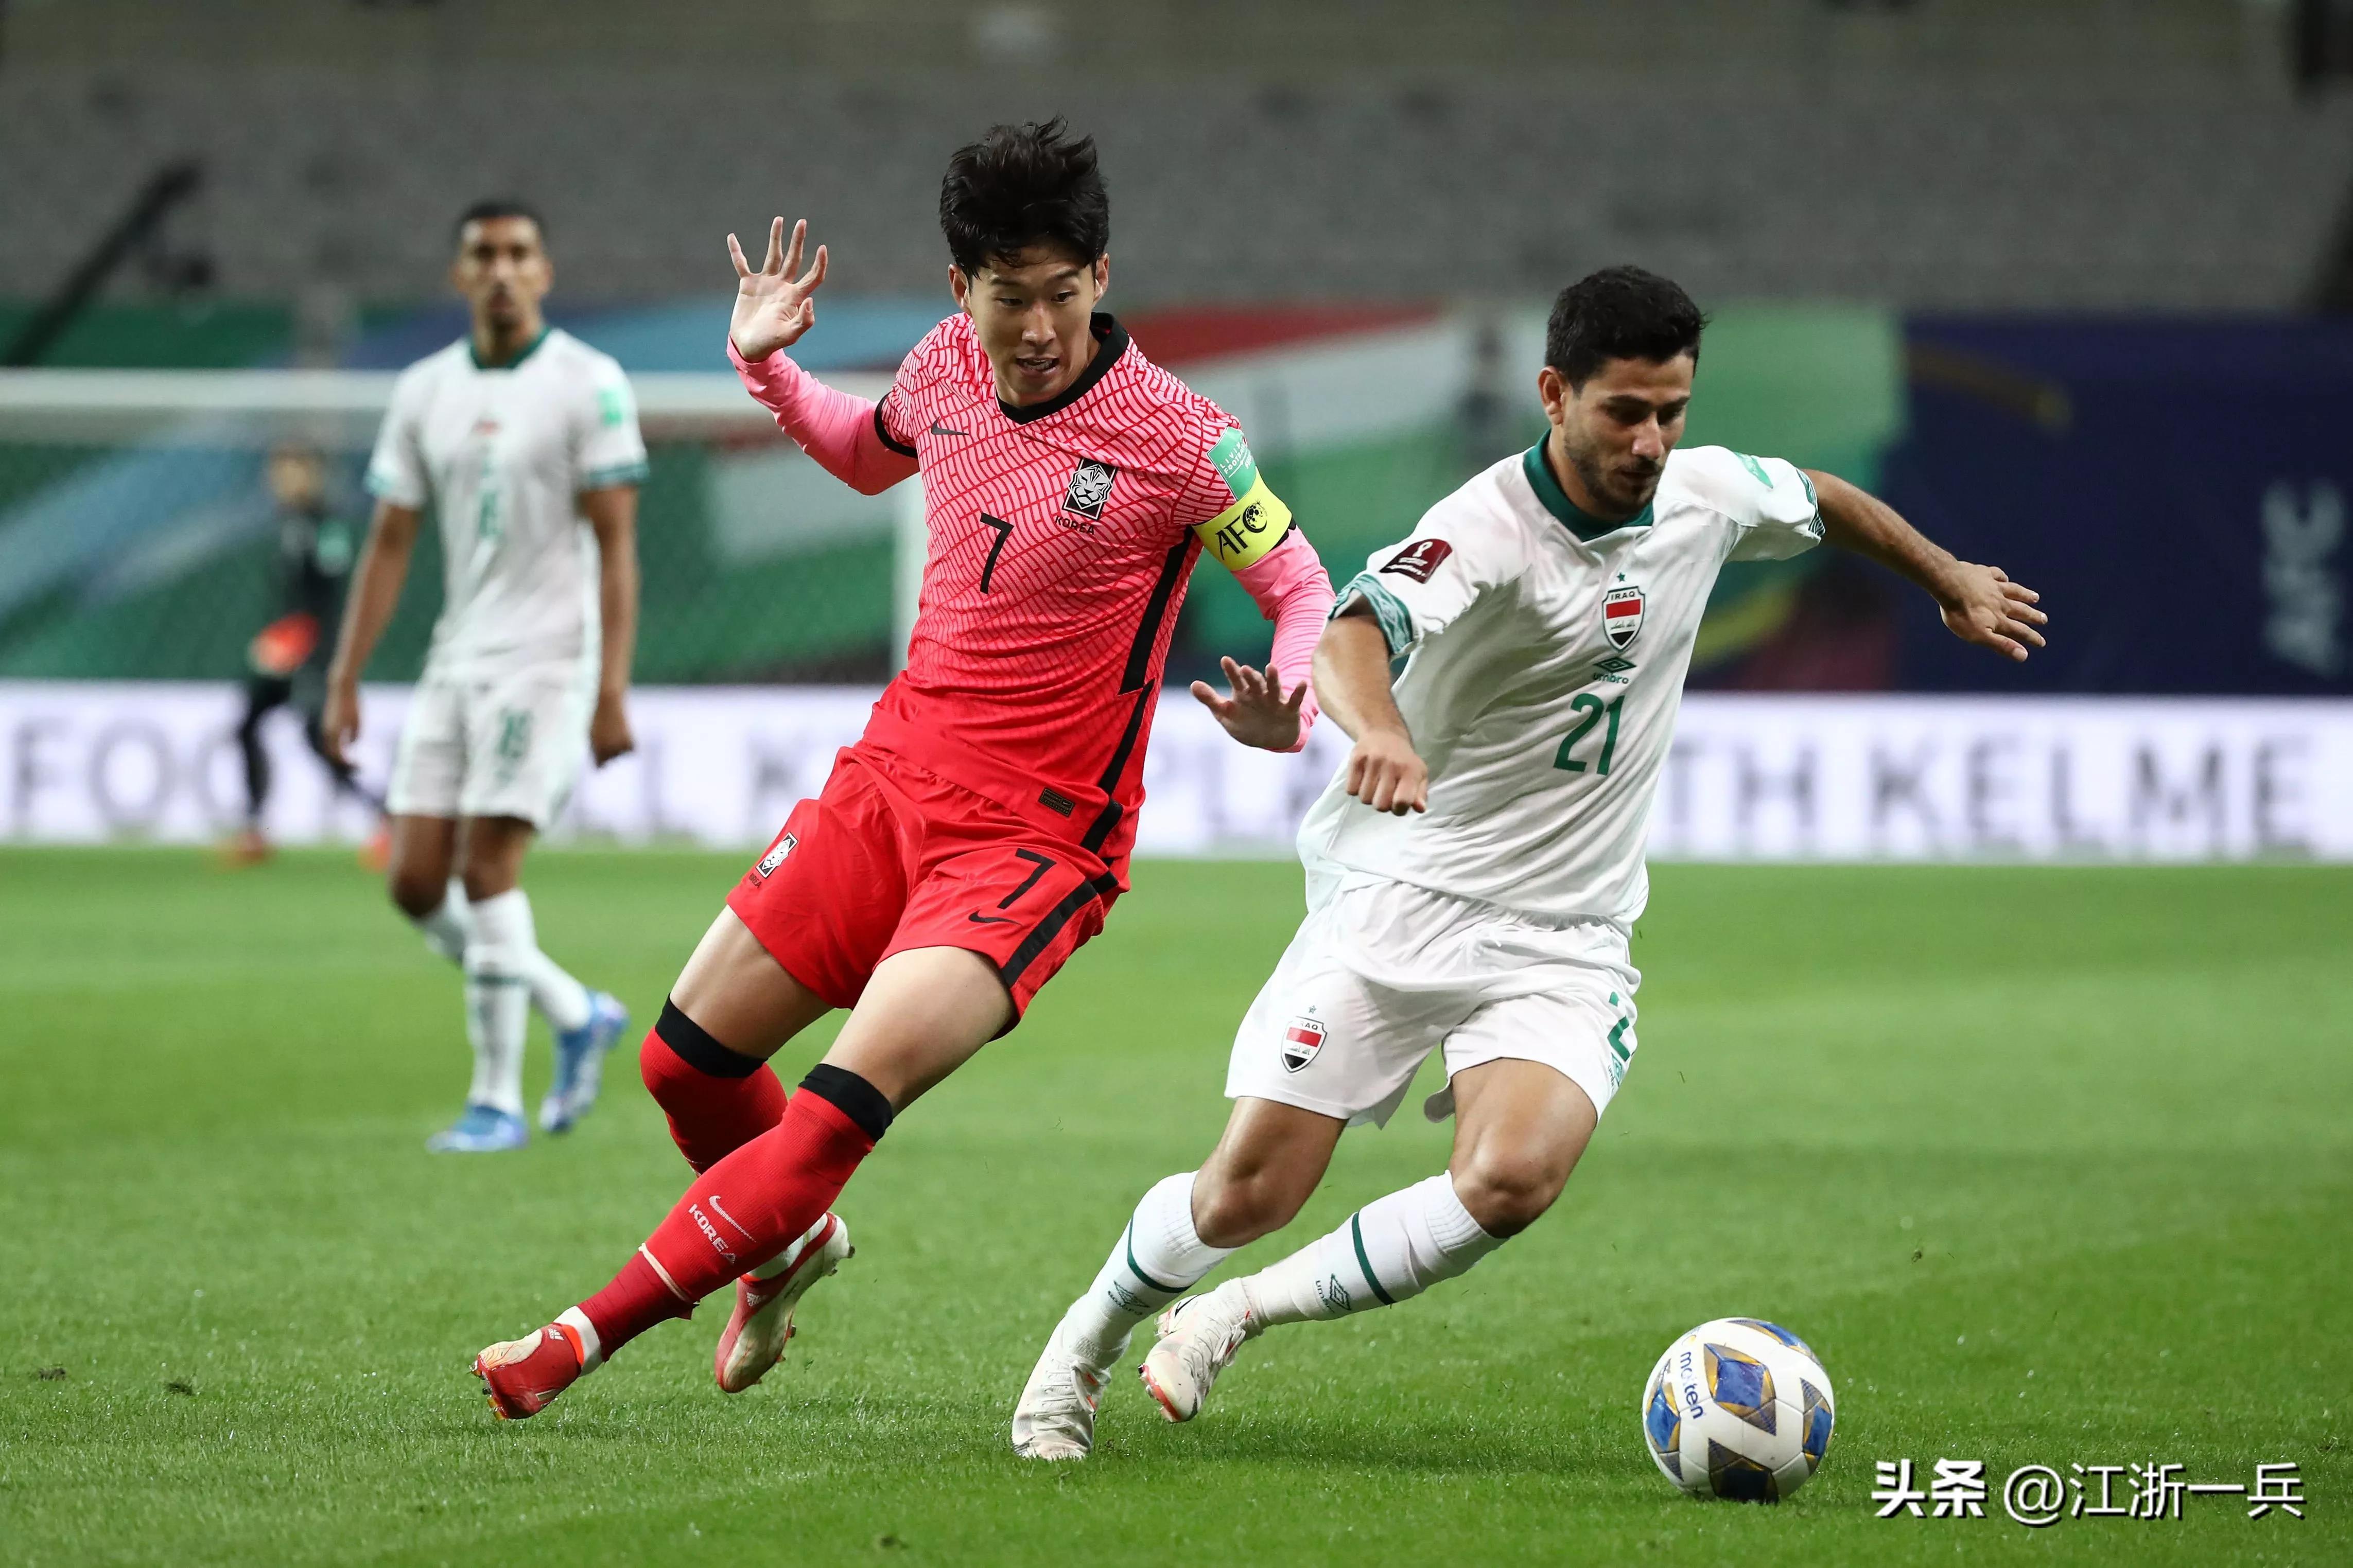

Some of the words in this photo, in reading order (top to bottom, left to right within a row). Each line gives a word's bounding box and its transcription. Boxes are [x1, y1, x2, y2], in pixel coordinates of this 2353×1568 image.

[980, 513, 1015, 594] 7
[1055, 515, 1094, 535] KOREA
[1215, 502, 1267, 560] AFC
[1611, 591, 1636, 601] IRAQ
[1593, 672, 1629, 684] umbro
[1553, 693, 1625, 776] 21
[1869, 736, 2309, 839] KELME
[997, 848, 1056, 909] 7
[688, 1204, 736, 1263] KOREA
